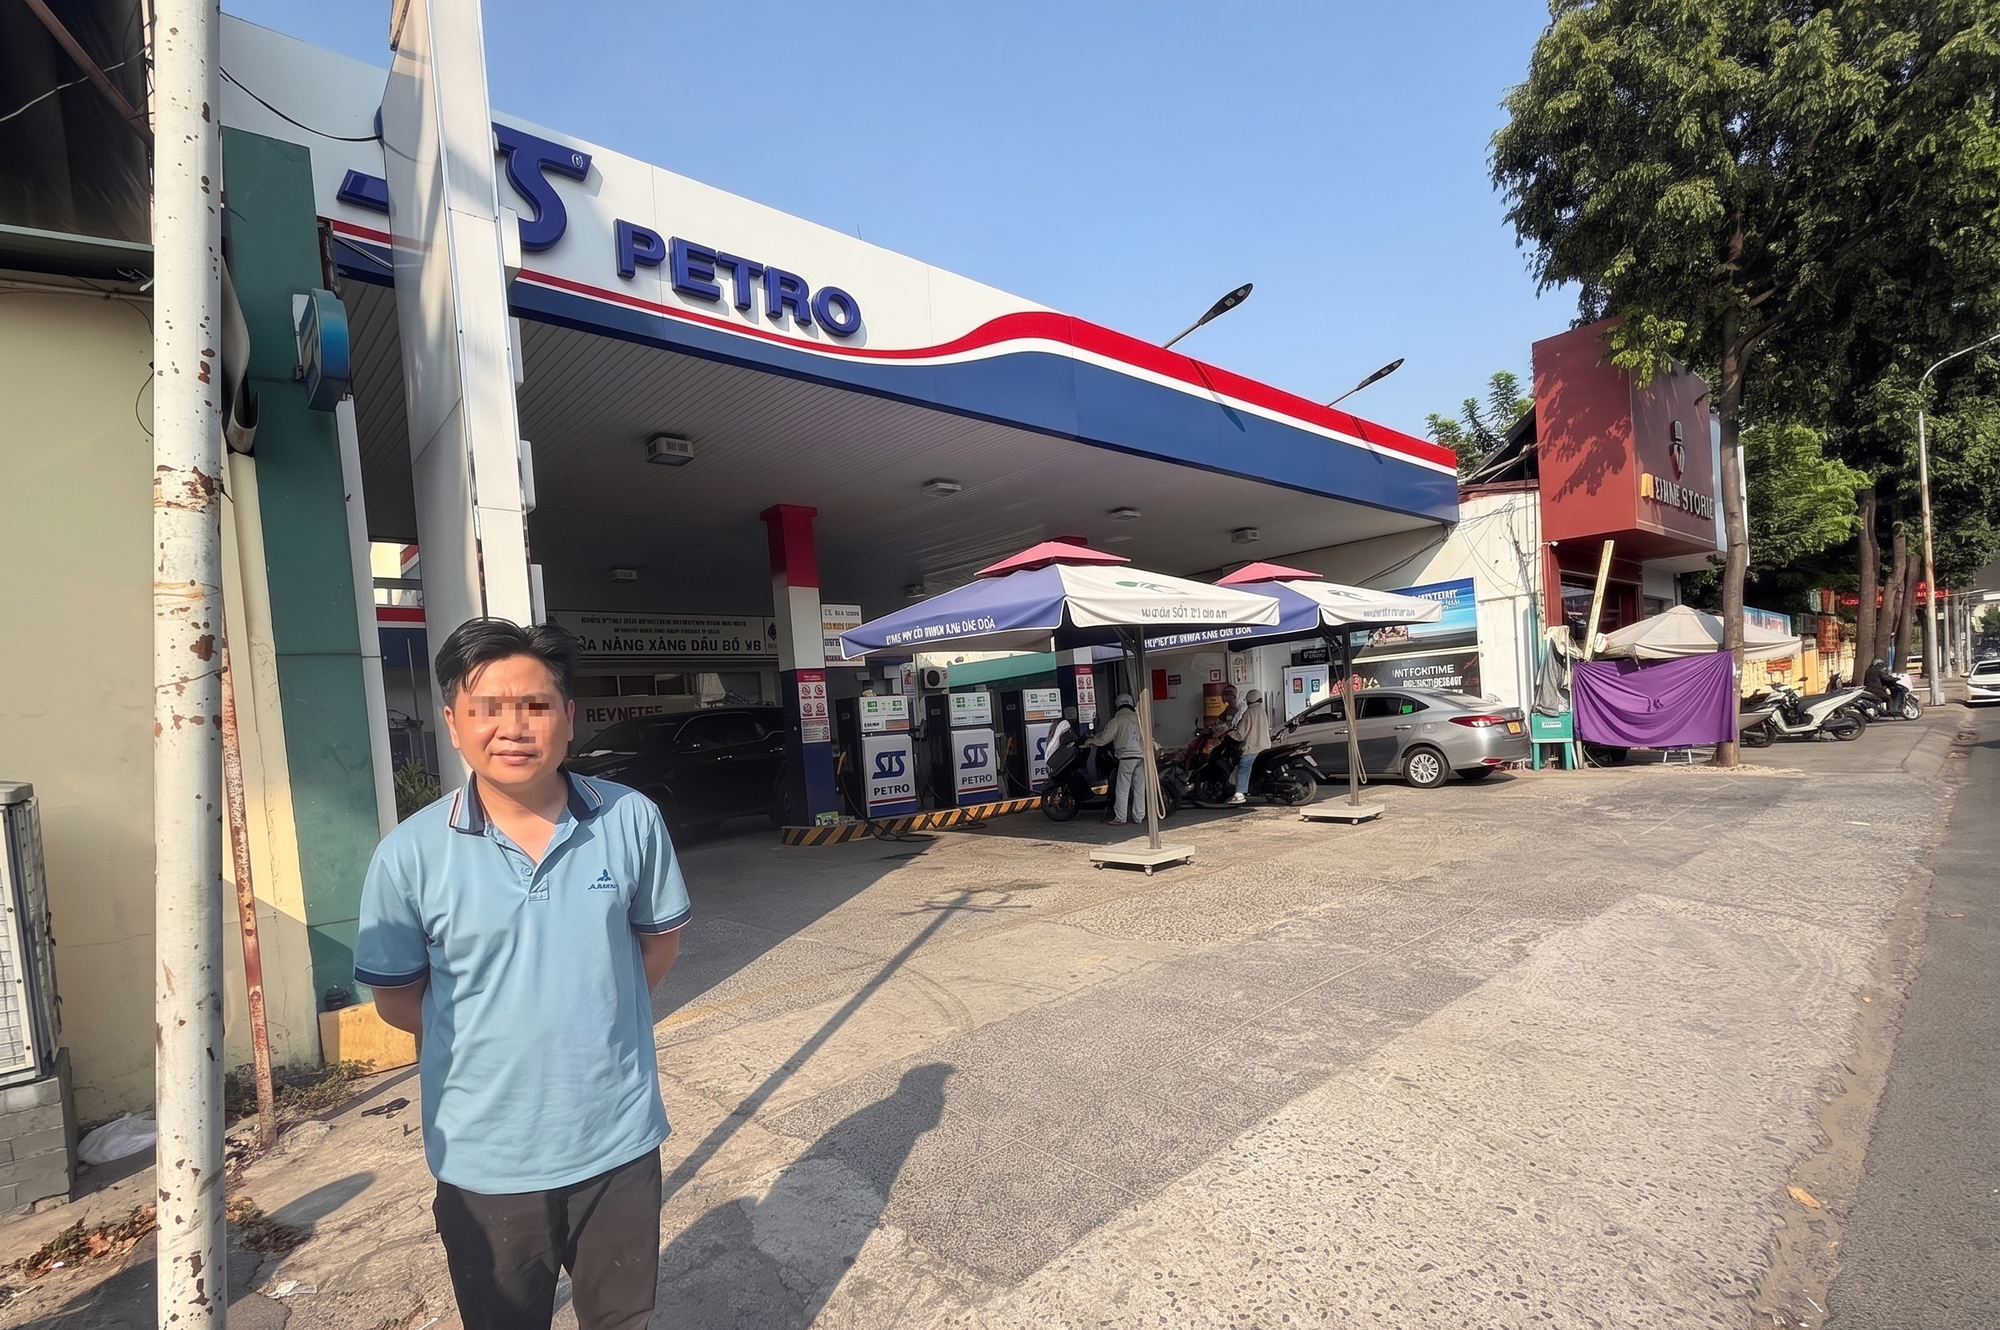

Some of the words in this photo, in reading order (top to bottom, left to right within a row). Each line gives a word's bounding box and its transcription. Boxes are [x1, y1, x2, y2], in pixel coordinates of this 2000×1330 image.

[614, 218, 862, 338] PETRO
[961, 774, 993, 785] PETRO
[873, 783, 910, 796] PETRO
